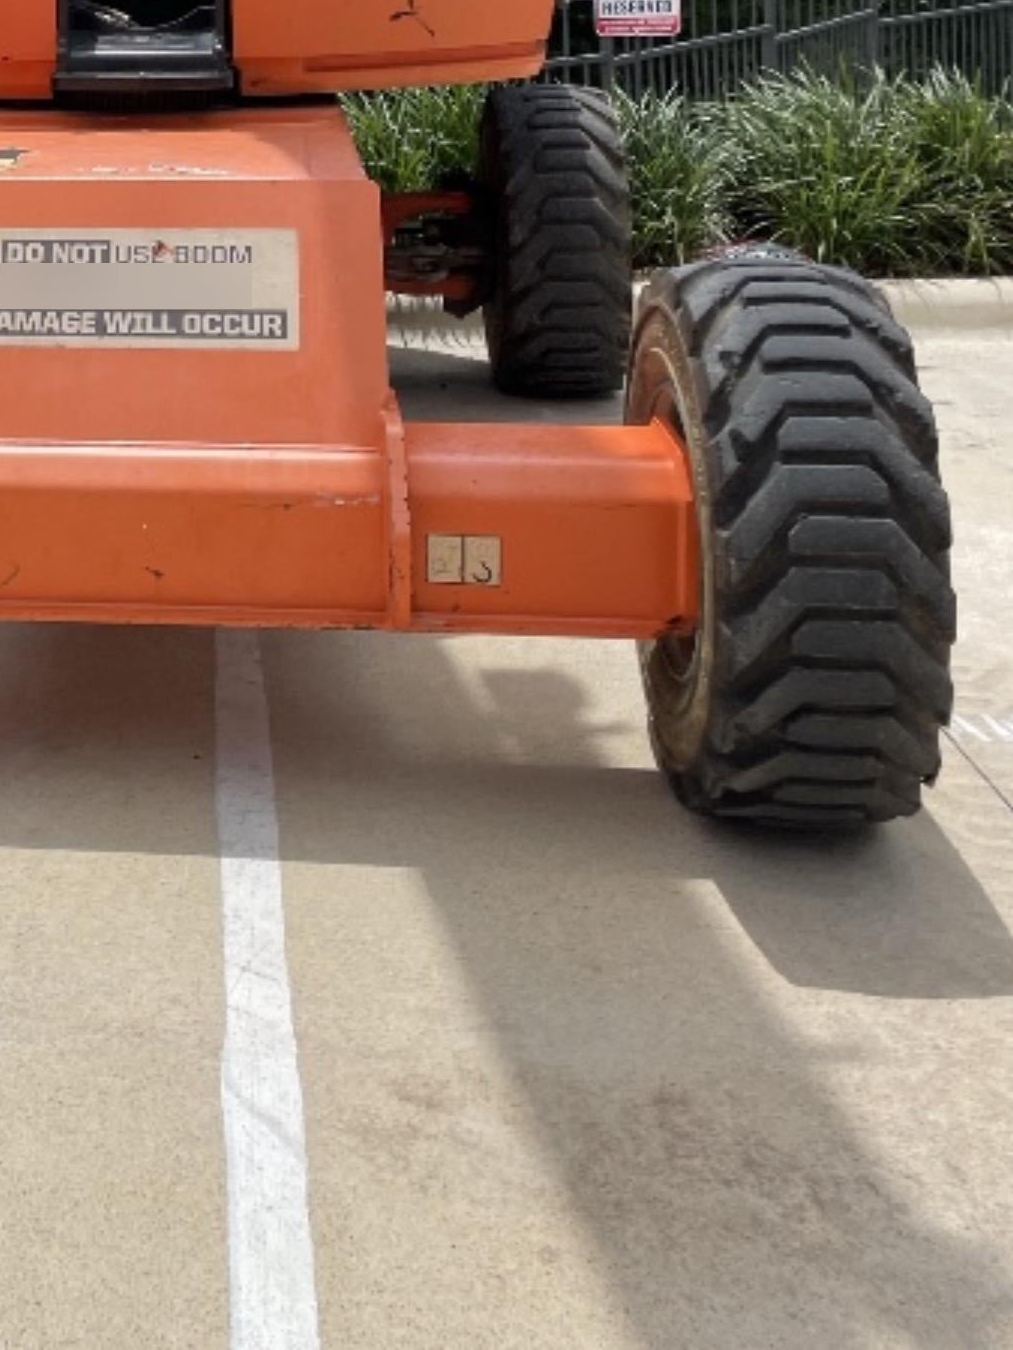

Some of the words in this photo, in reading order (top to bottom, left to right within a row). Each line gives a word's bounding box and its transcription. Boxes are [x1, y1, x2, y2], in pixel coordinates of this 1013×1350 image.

[7, 241, 45, 263] DO
[52, 242, 108, 263] NOT
[175, 244, 253, 264] BOOM
[102, 311, 177, 335] WILL
[182, 313, 283, 337] OCCUR
